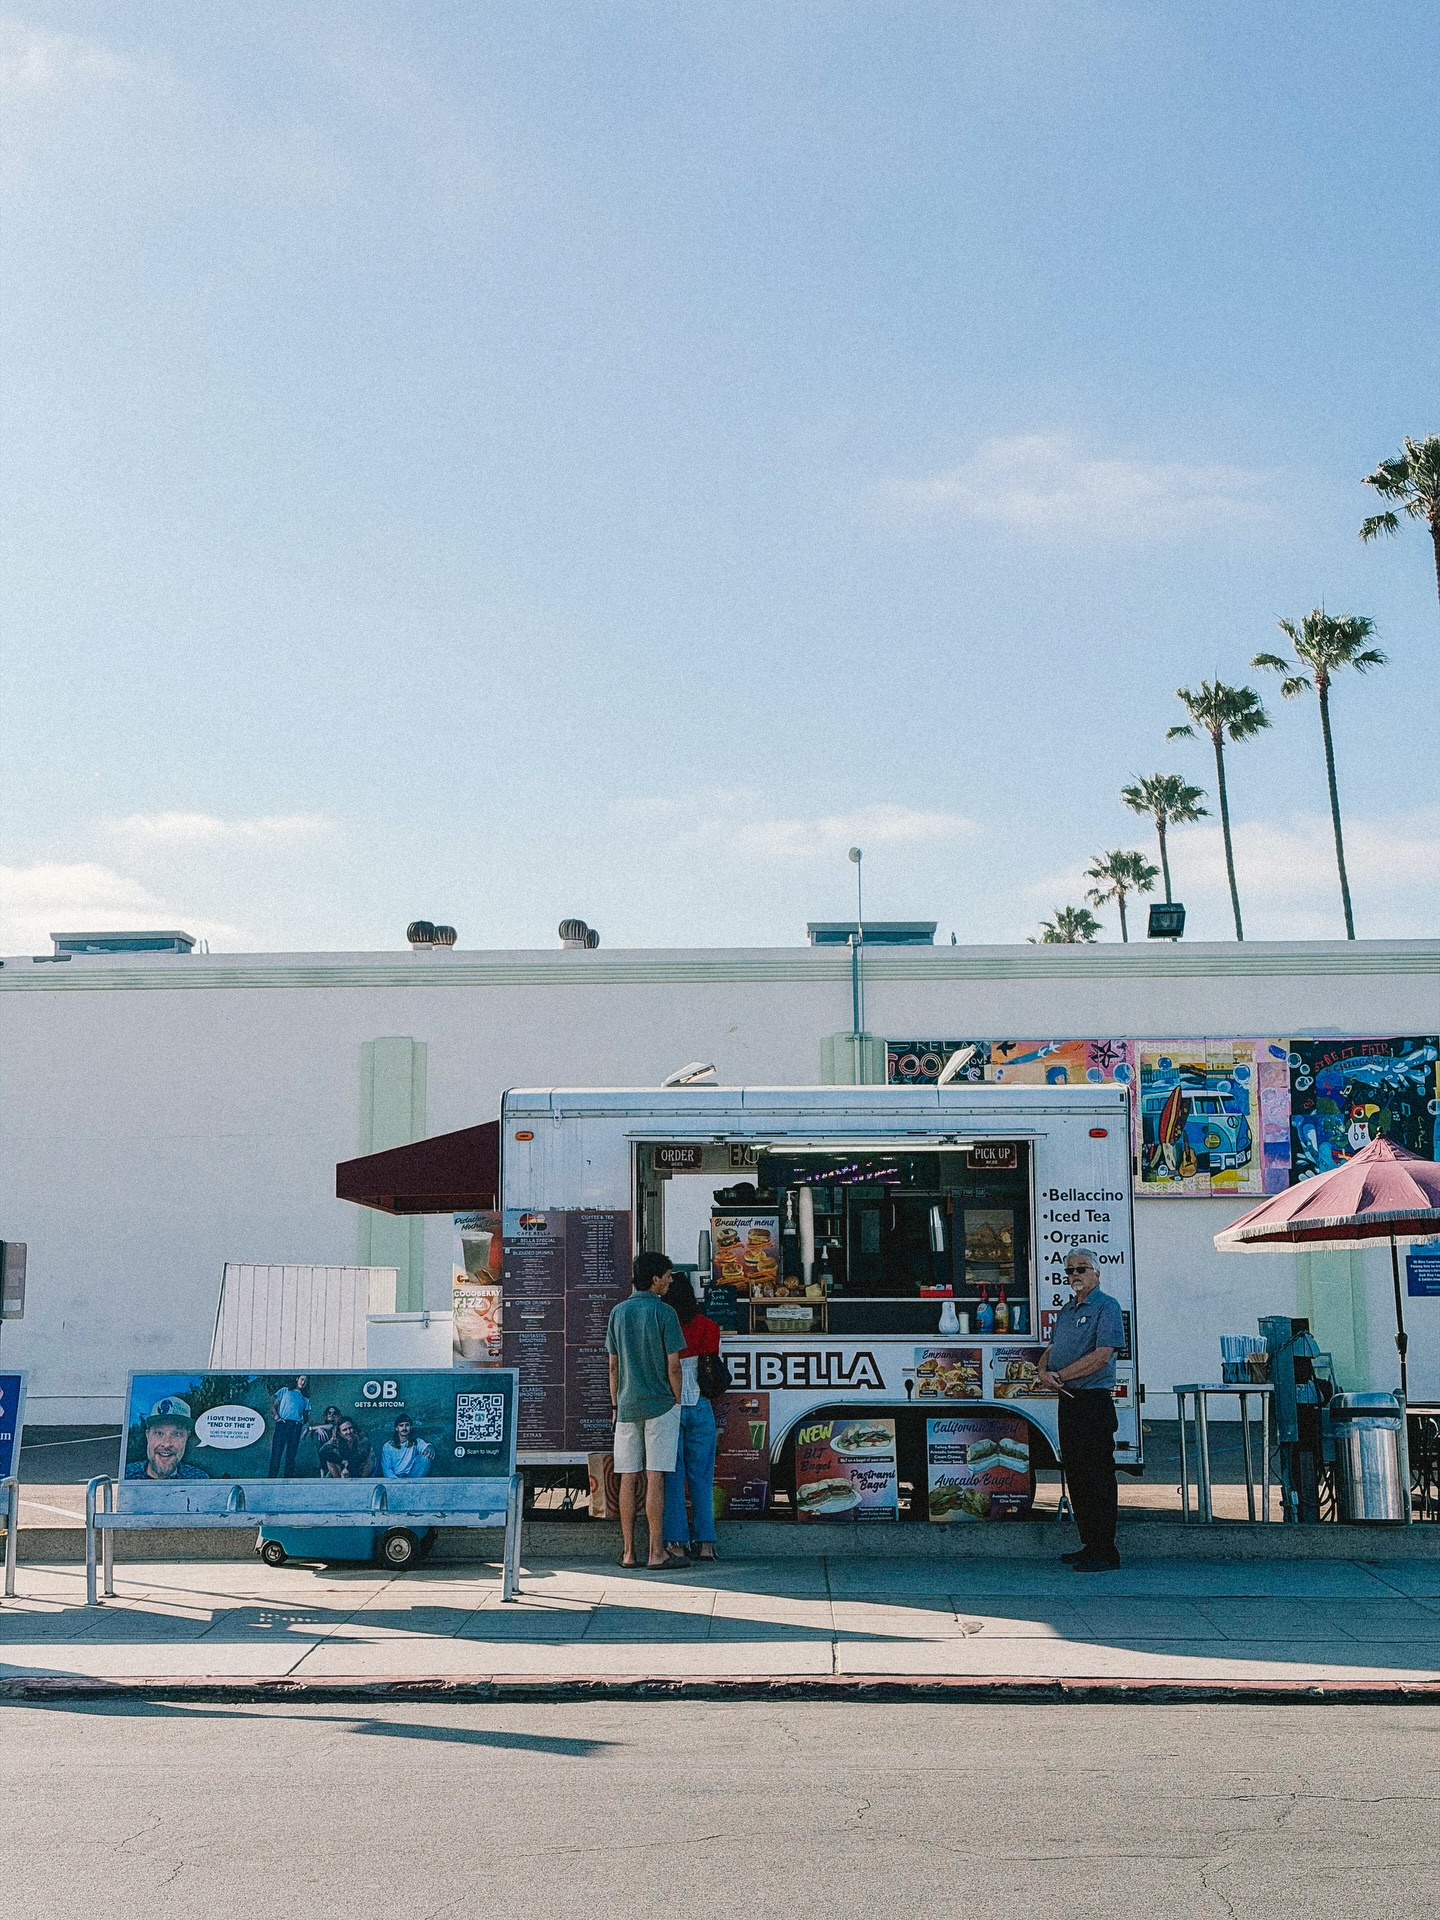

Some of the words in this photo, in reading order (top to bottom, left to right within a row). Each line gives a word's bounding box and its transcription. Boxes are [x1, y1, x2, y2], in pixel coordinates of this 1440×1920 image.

[661, 1150, 694, 1162] ORDER
[975, 1148, 996, 1159] PICK
[998, 1148, 1010, 1159] UP
[1050, 1188, 1124, 1202] Bellaccino
[714, 1218, 754, 1227] Breakfast
[1050, 1210, 1080, 1222] Iced
[1085, 1210, 1110, 1222] Tea
[1050, 1230, 1109, 1247] Organic
[1052, 1294, 1064, 1307] &
[756, 1352, 886, 1390] BELLA
[362, 1380, 398, 1399] OB
[798, 1420, 834, 1446] NEW
[933, 1421, 984, 1435] California
[804, 1447, 827, 1459] BLT
[850, 1469, 896, 1482] Pastrami
[934, 1473, 980, 1488] Avocado
[983, 1474, 1015, 1488] Bagel
[860, 1479, 888, 1494] Bagel
